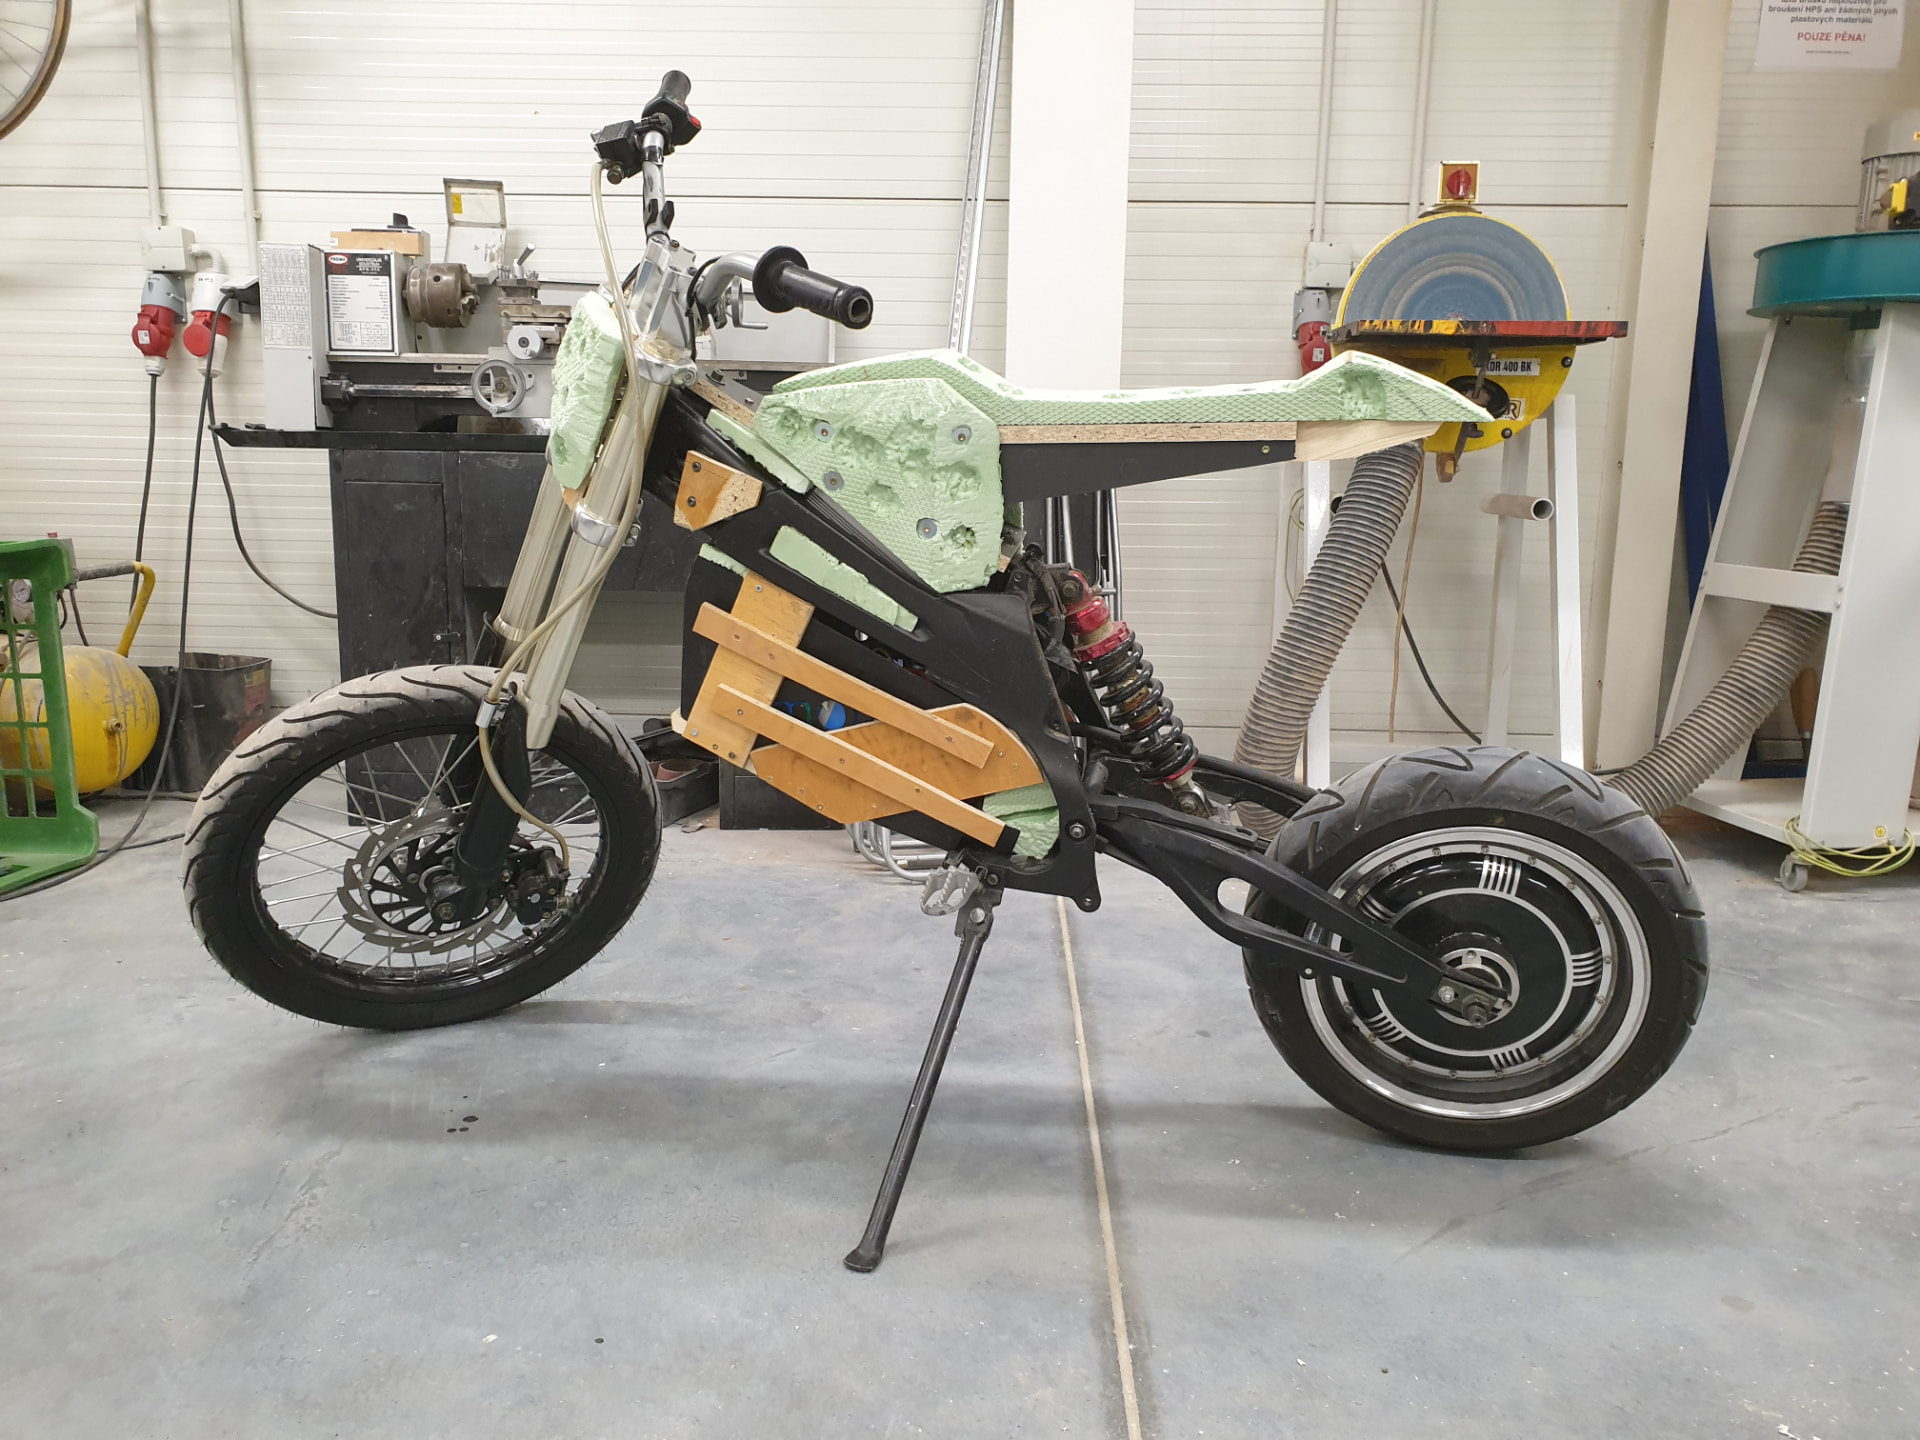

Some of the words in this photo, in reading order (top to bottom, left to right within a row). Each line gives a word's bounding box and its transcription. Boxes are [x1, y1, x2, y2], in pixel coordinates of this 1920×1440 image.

[1805, 5, 1822, 13] HPS
[1838, 6, 1872, 15] žádných
[1790, 16, 1834, 24] plastových
[1797, 32, 1832, 42] POUZE
[1834, 30, 1866, 42] PĚNA!
[1502, 361, 1519, 372] 400
[1520, 361, 1532, 372] BK
